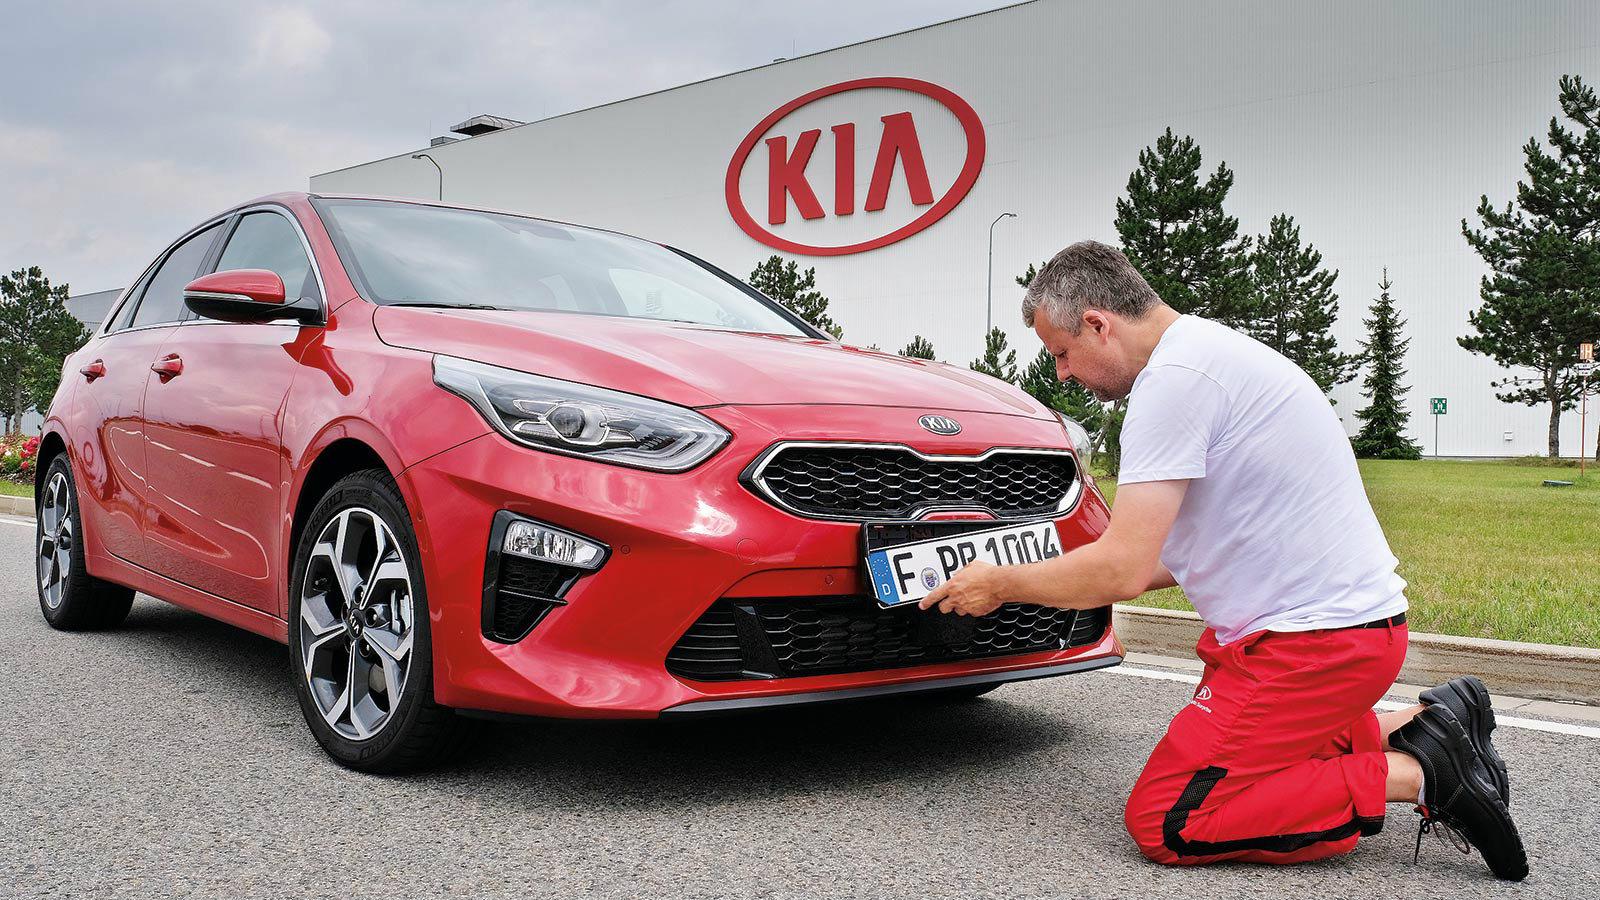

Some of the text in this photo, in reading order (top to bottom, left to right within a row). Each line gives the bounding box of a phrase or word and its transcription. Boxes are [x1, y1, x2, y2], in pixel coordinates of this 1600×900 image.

[765, 111, 935, 225] KIA
[923, 417, 958, 430] KIA
[893, 552, 915, 595] F
[985, 527, 1060, 567] 1004
[883, 583, 891, 596] D
[349, 612, 360, 635] KIA
